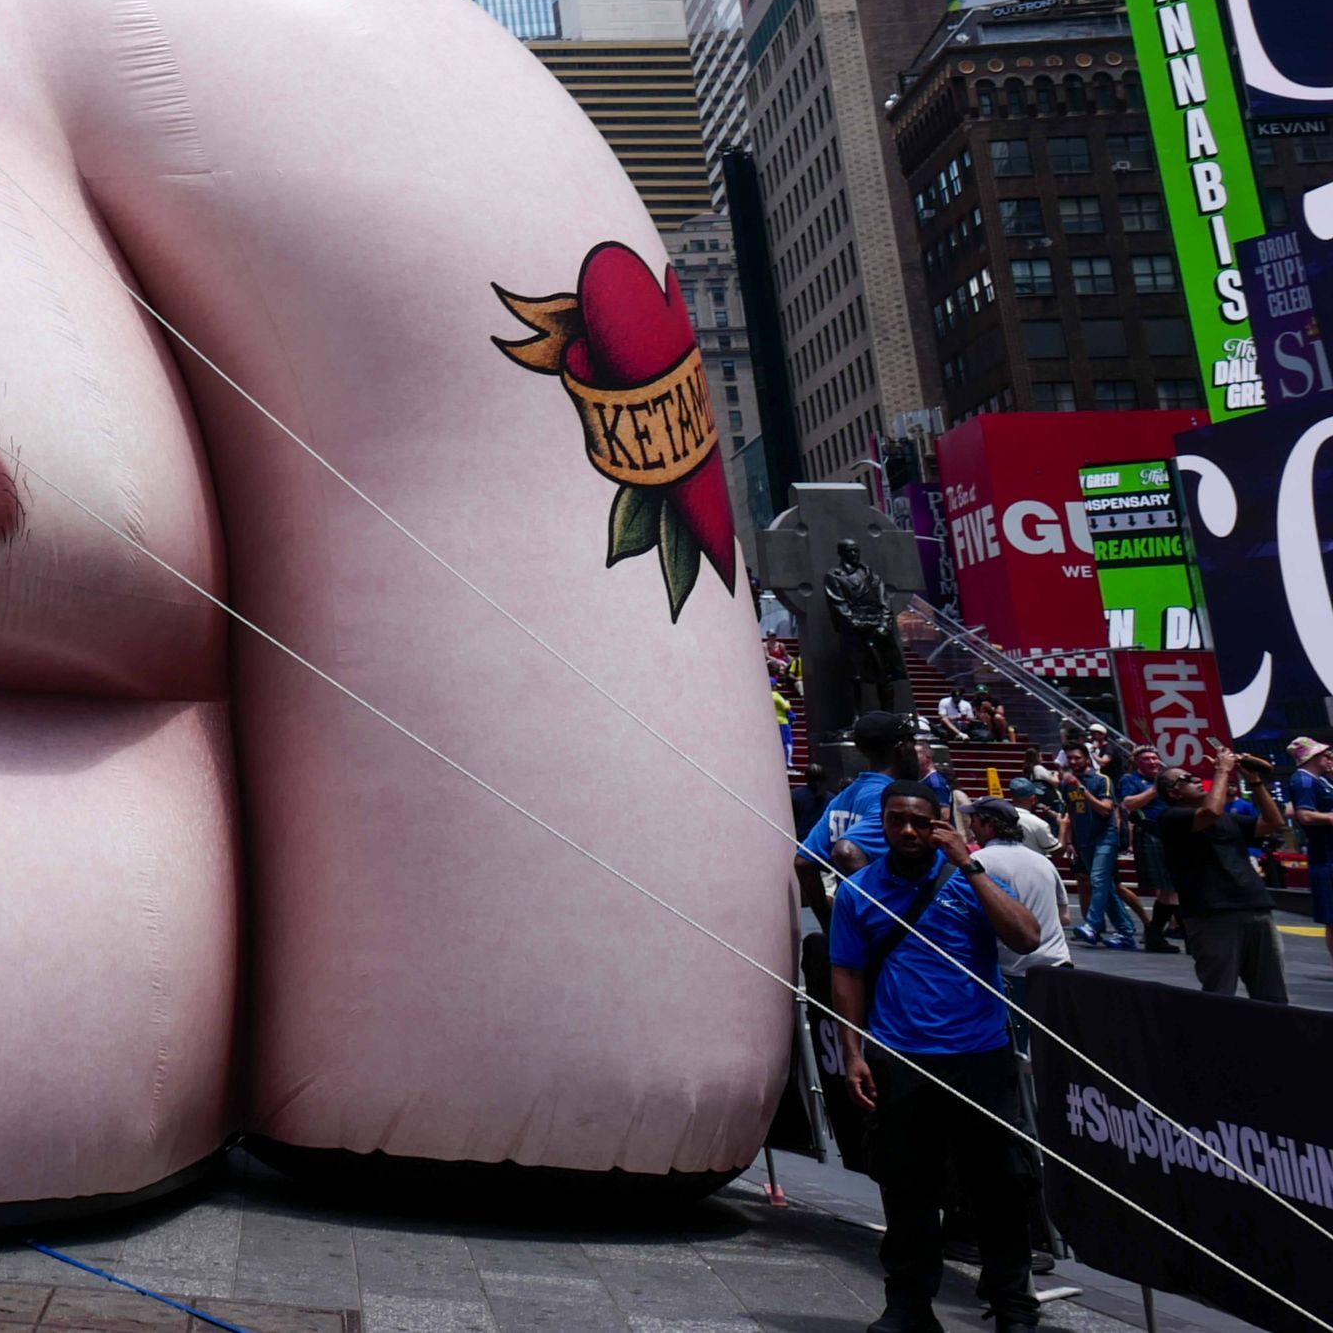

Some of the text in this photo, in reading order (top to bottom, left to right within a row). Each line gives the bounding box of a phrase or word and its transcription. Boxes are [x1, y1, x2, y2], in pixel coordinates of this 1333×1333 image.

[1256, 121, 1327, 137] KEVANI
[1084, 492, 1171, 512] ISPENSARY
[951, 503, 1002, 571] FIVE
[1143, 659, 1210, 767] tkts
